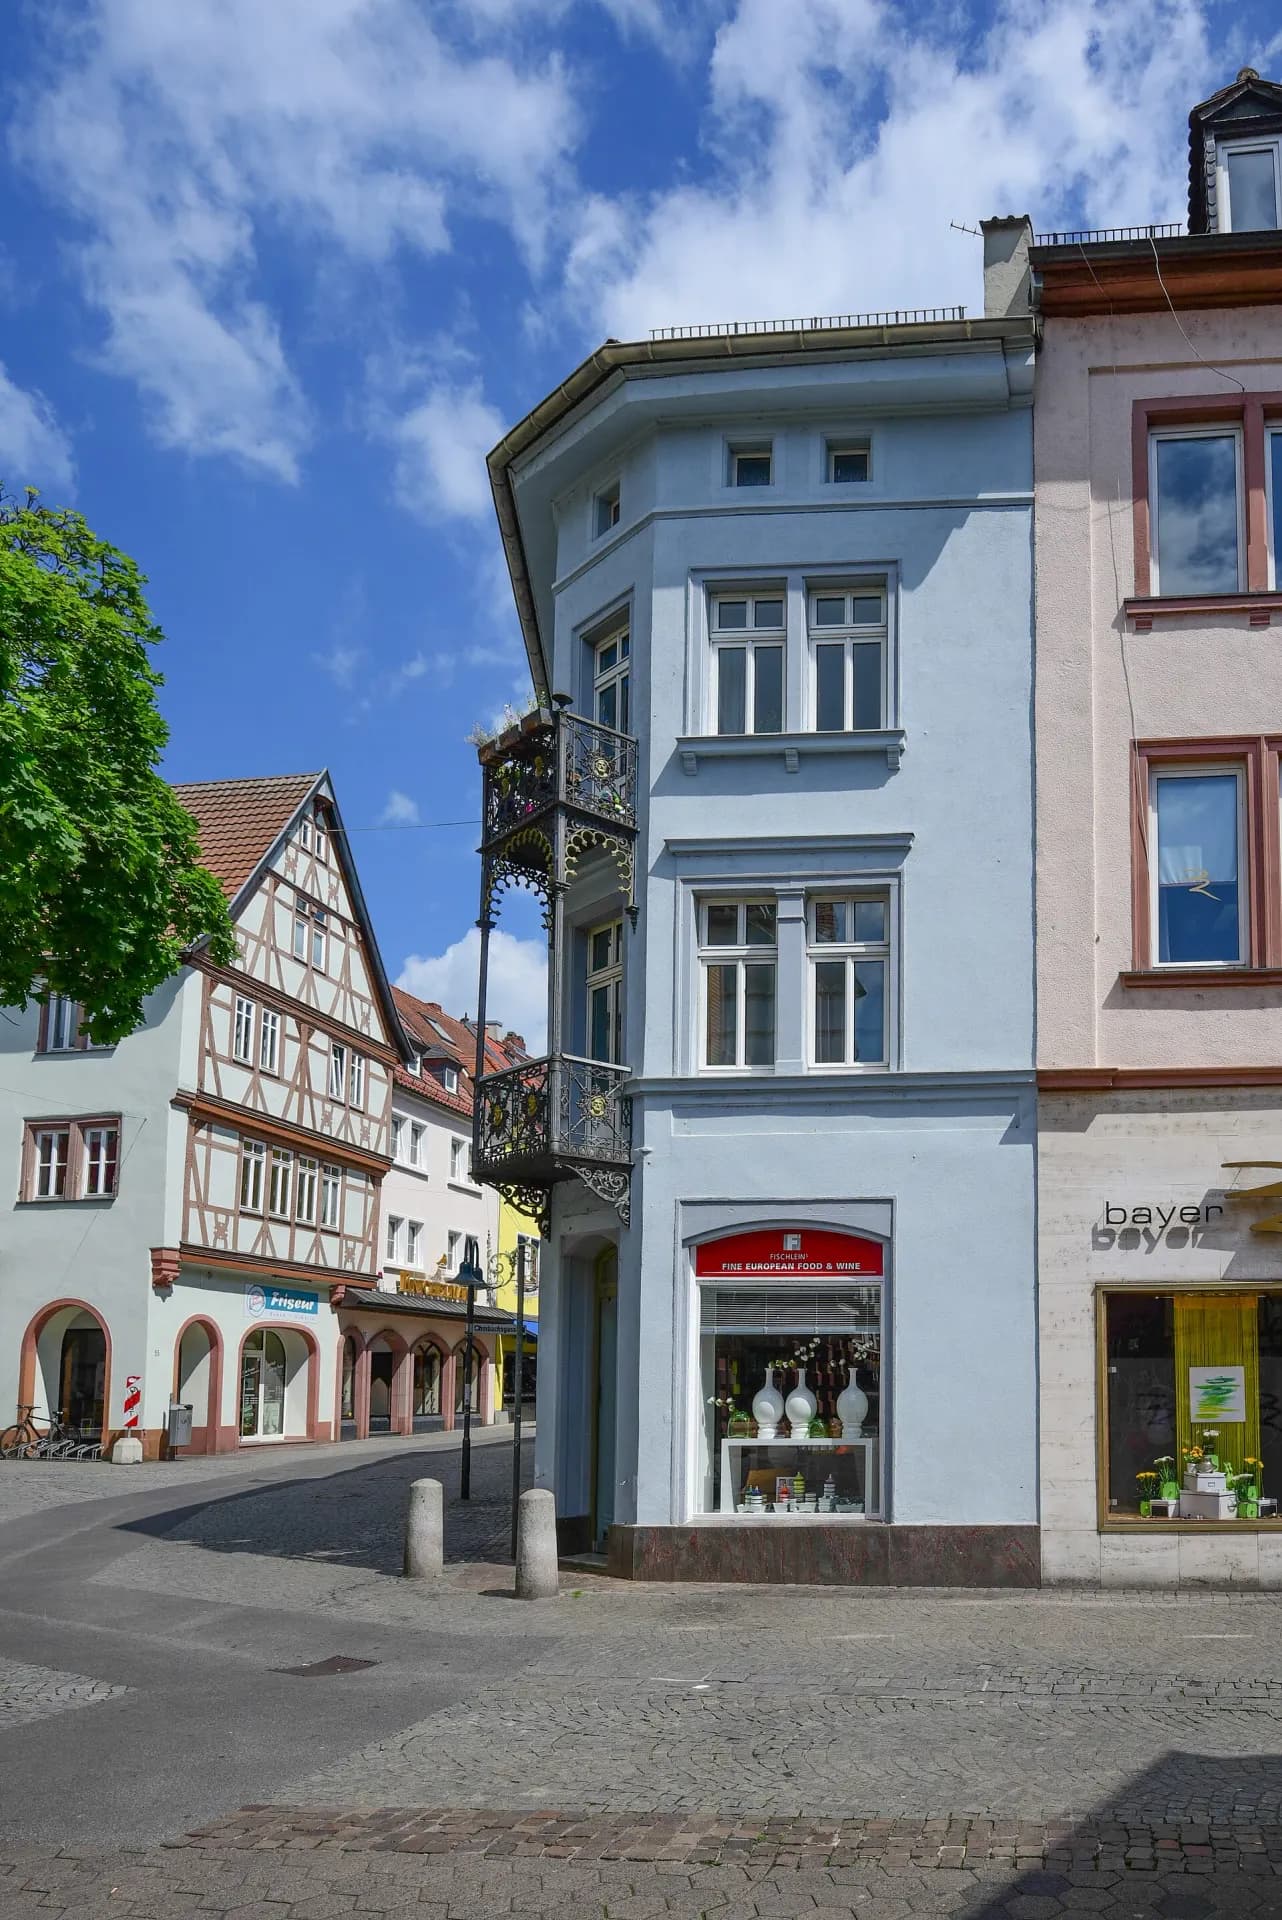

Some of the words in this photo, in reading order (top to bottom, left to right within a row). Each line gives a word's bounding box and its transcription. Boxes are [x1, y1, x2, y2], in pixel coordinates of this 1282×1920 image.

[1105, 1201, 1223, 1228] bayer
[722, 1263, 743, 1271] FINE
[745, 1263, 795, 1271] EUROPEAN
[270, 1291, 314, 1310] Friseur
